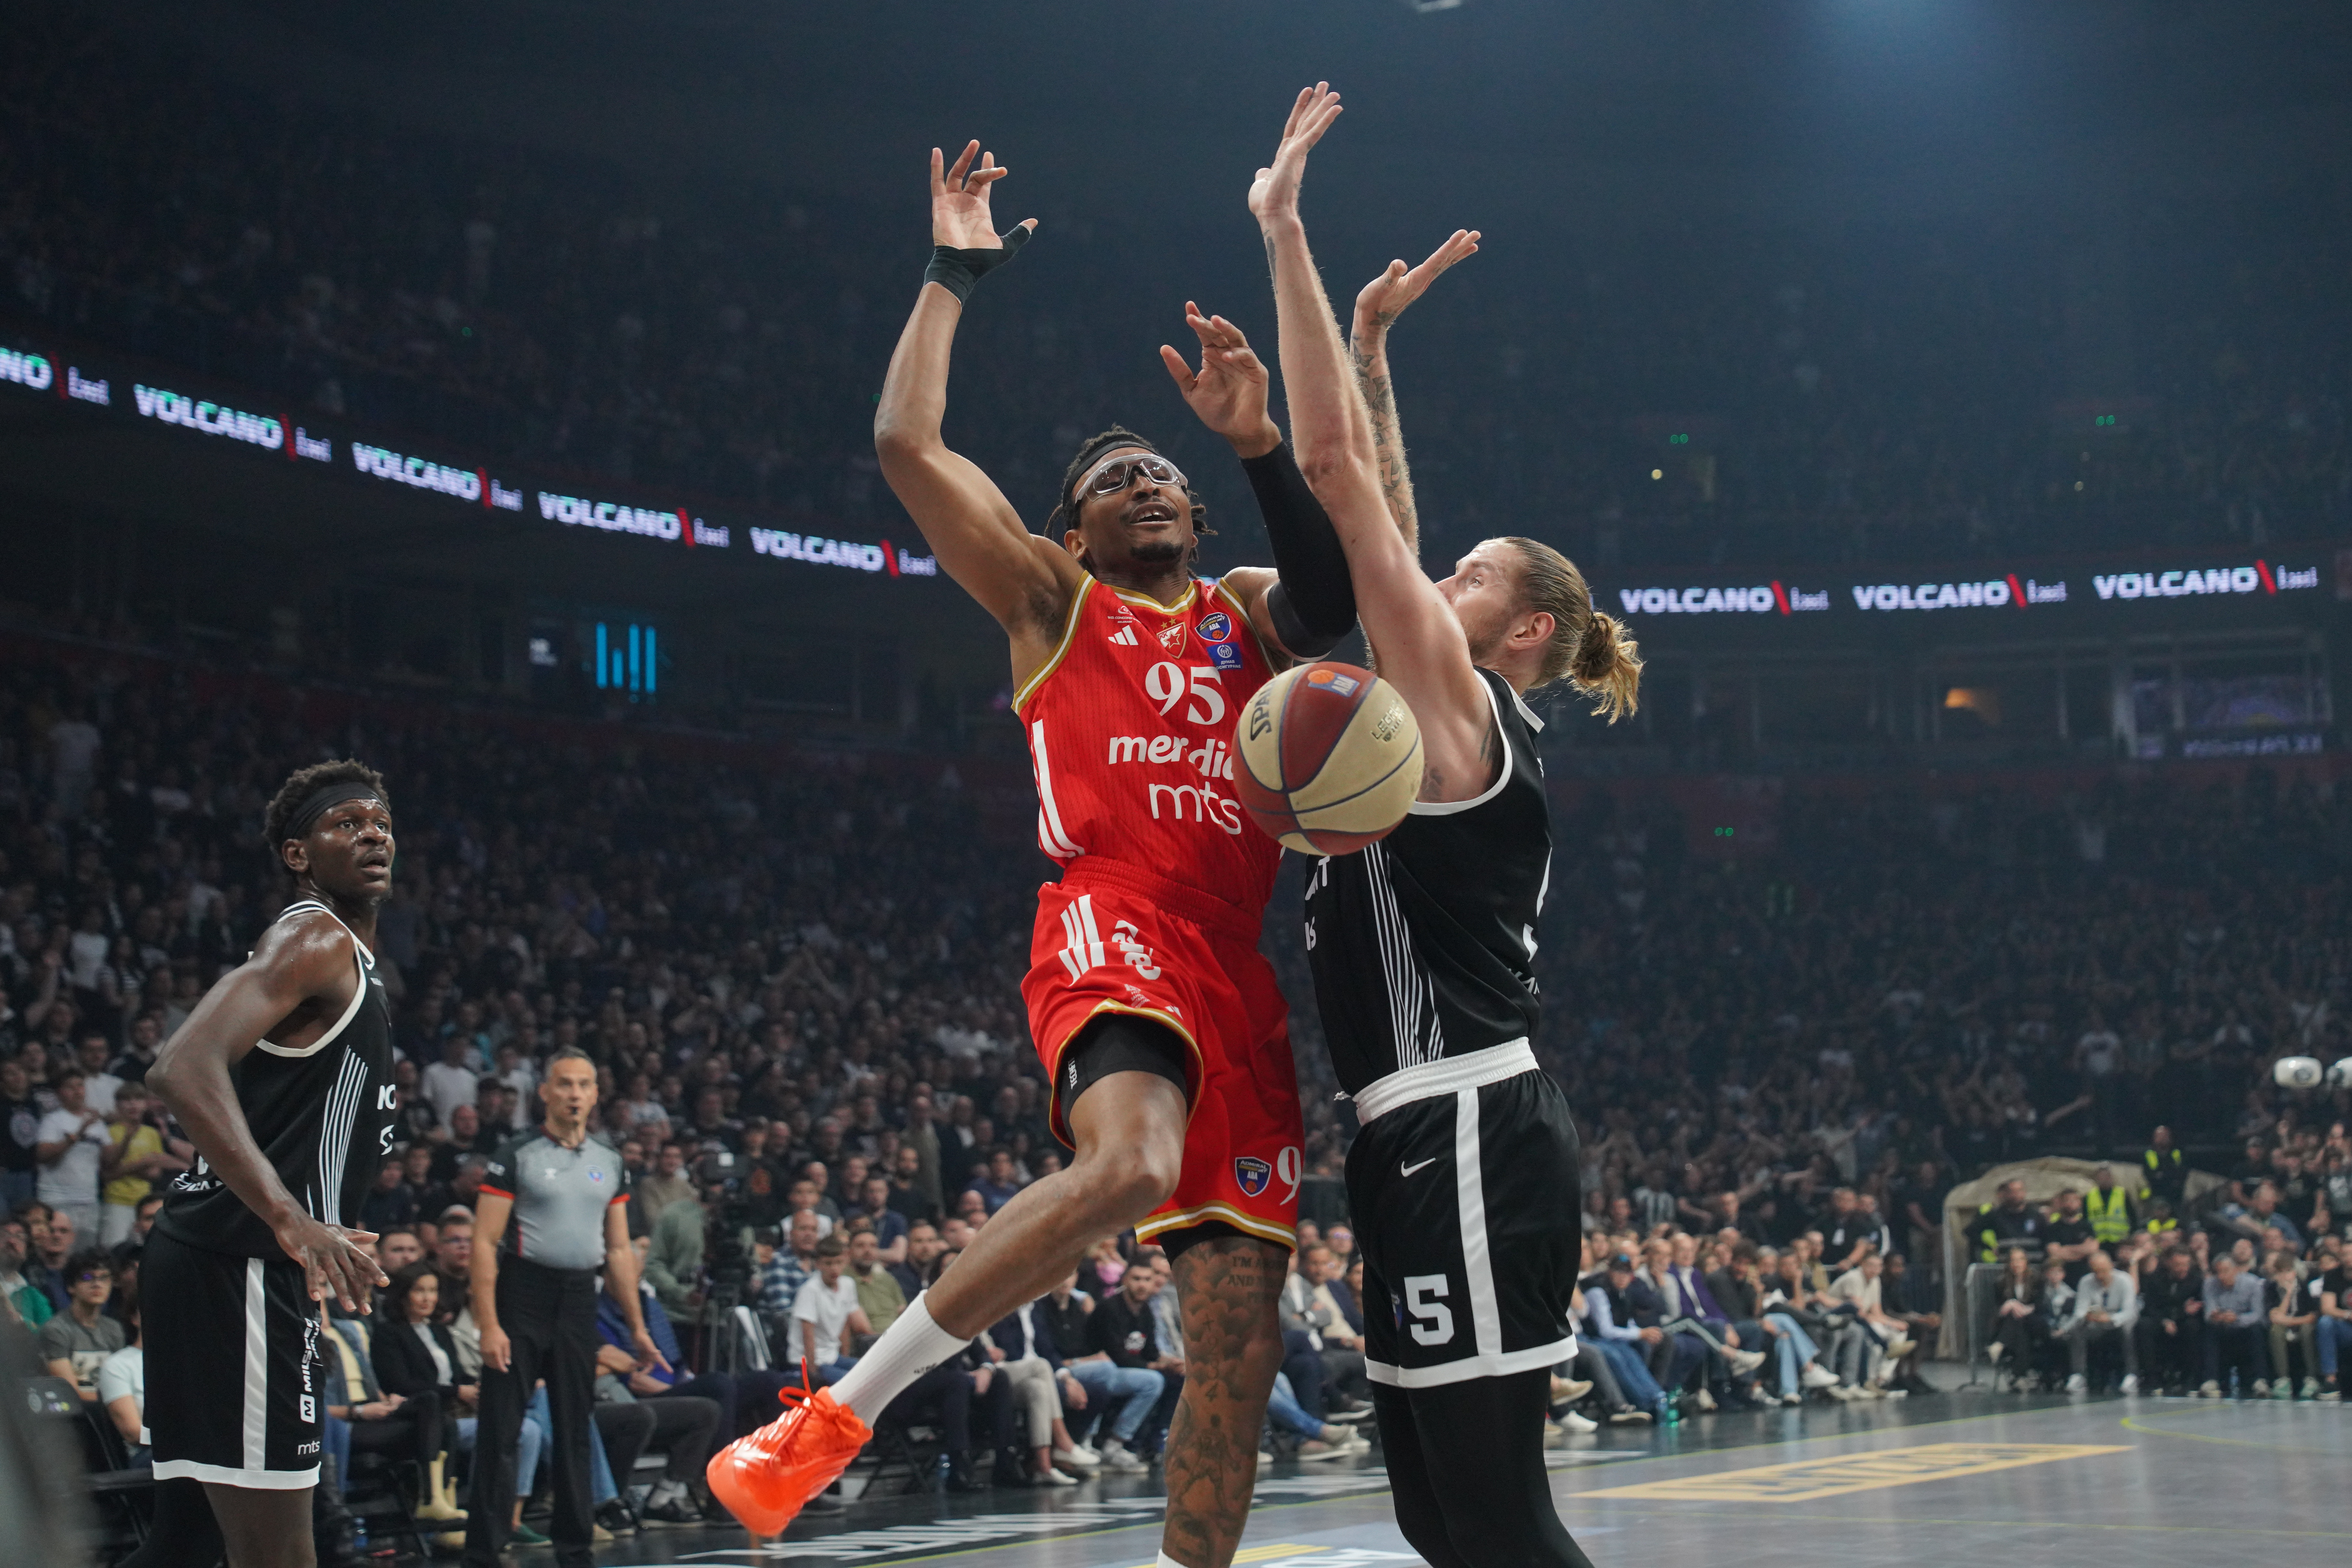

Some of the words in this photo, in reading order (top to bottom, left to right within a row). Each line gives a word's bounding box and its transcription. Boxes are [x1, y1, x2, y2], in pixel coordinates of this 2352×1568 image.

[134, 384, 283, 450] VOLCANO
[352, 442, 481, 502] VOLCANO
[538, 491, 682, 541] VOLCANO
[749, 527, 884, 572] VOLCANO
[1620, 586, 1775, 613] VOLCANO
[1852, 579, 2010, 612] VOLCANO
[2092, 567, 2259, 601] VOLCANO
[1160, 632, 1168, 640] KK
[1200, 614, 1225, 628] ADMIRAL
[1208, 622, 1220, 631] ABA
[1146, 661, 1225, 725] 95
[1331, 676, 1356, 696] ABA
[1149, 781, 1241, 835] mts
[1240, 1160, 1267, 1169] ADMIRAL
[1247, 1170, 1258, 1180] ABA
[1277, 1146, 1301, 1205] 9
[1404, 1274, 1455, 1346] 5
[298, 1440, 320, 1456] mts
